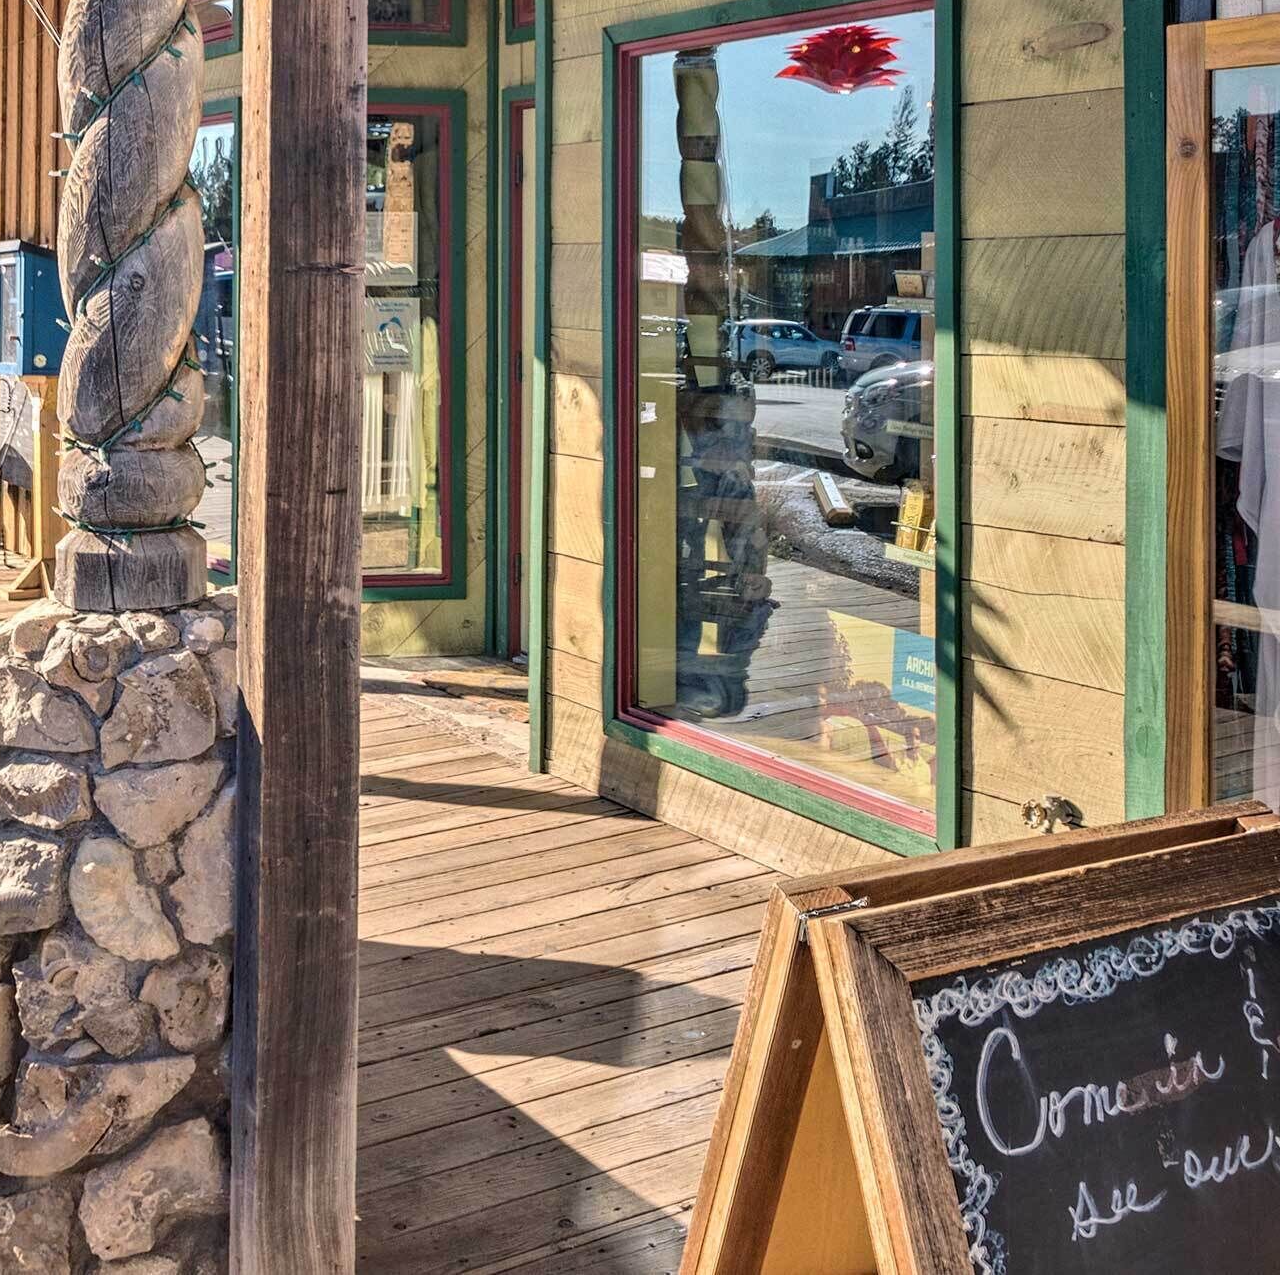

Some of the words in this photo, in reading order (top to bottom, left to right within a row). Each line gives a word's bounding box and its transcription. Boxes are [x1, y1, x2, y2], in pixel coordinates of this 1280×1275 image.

[976, 1026, 1150, 1157] Come
[1154, 1032, 1226, 1094] in
[1068, 1179, 1168, 1242] see
[1183, 1126, 1274, 1189] our
